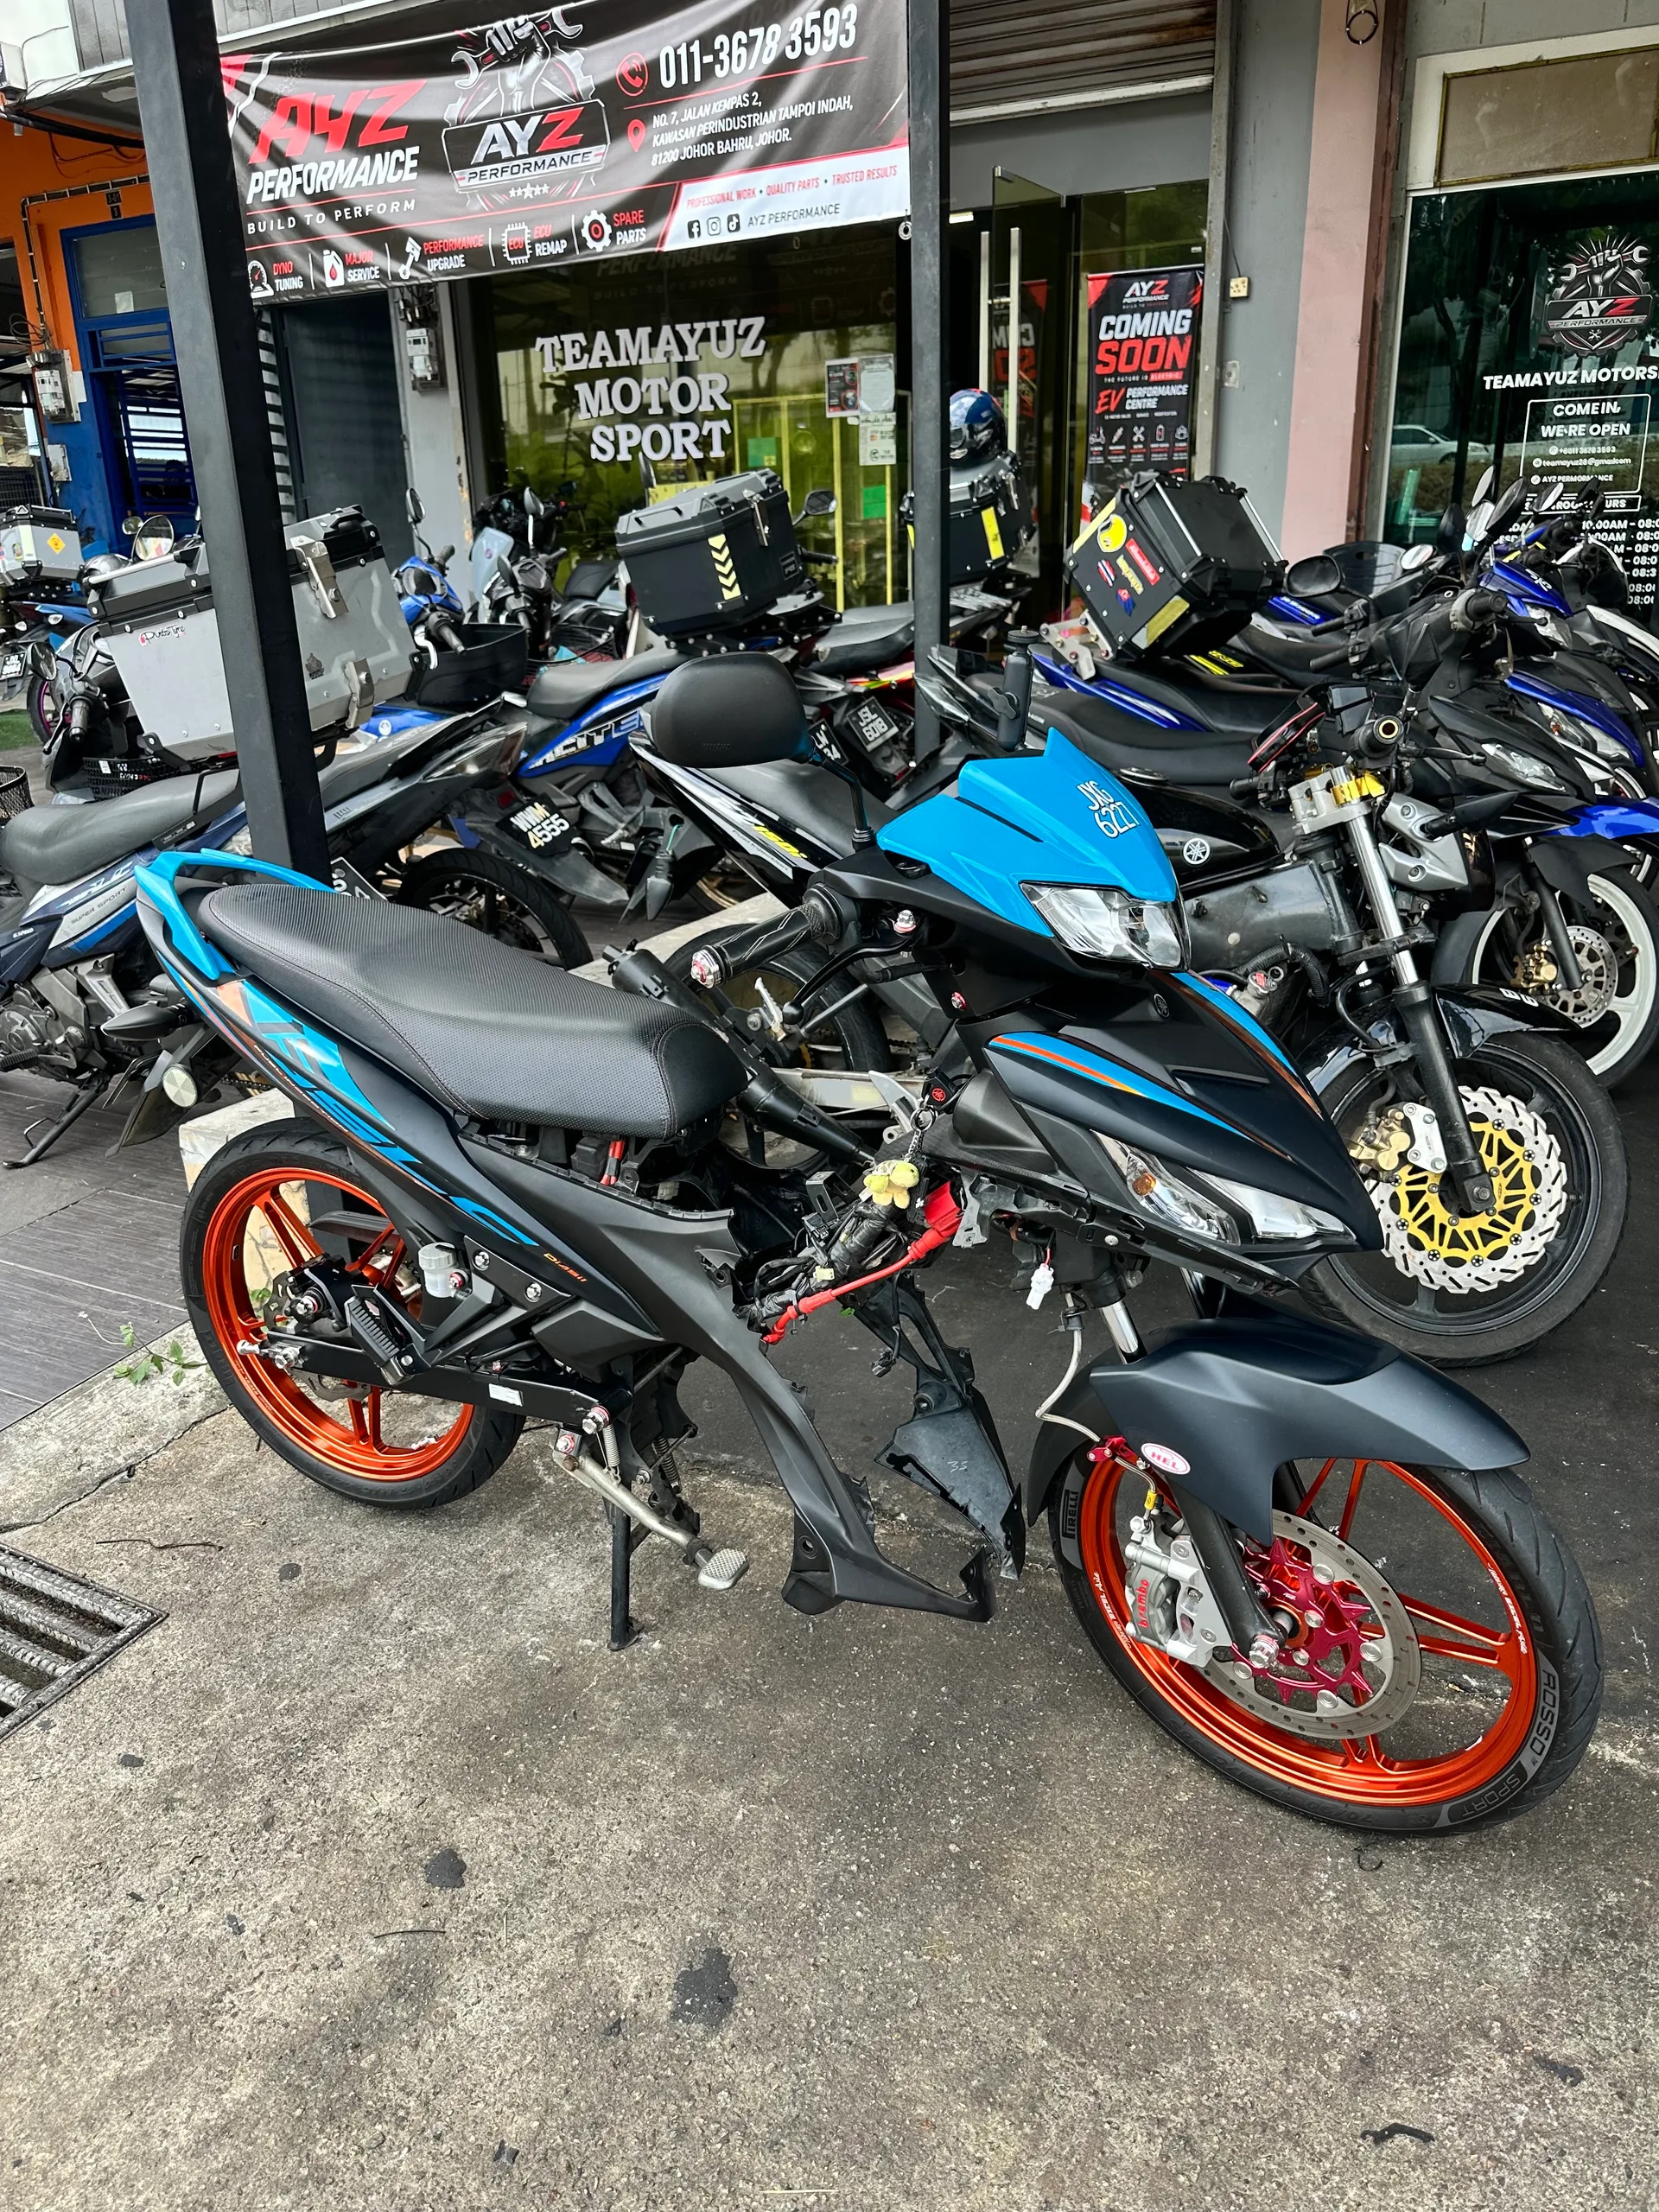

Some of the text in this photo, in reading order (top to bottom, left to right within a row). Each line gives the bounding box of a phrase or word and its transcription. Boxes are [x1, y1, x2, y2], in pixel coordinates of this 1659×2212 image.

[659, 3, 858, 88] 011-3678 3593
[248, 79, 427, 164] AYZ
[652, 92, 762, 129] NO. 7, JALAN KEMPAS 2,
[652, 95, 854, 148] KAWASAN PERINDUSTRIAN TAMPOI INDAH,
[471, 107, 583, 164] AYZ
[652, 129, 791, 167] 81200 JOHOR BAHRU, JOHOR.
[246, 145, 420, 204] PERFORMANCE
[467, 150, 593, 183] PERFORMANCE
[687, 165, 898, 209] PROFESSIONAL WORK QUALITY PARTS TRUSTED RESULTS
[248, 200, 416, 234] BUILD TO PERFORM
[613, 209, 645, 226] SPARE
[747, 203, 840, 228] AYZ PERFORMANCE
[423, 234, 484, 254] PERFORMANCE
[508, 236, 524, 250] ECU
[533, 224, 552, 239] ECU
[616, 228, 646, 245] PARTS
[346, 251, 373, 265] MAJOR
[427, 254, 465, 272] UPGRADE
[535, 240, 568, 257] REMAP
[273, 261, 293, 275] DYNO
[346, 265, 380, 283] SERVICE
[274, 276, 303, 291] TUNING
[1125, 280, 1168, 297] AYZ
[1556, 316, 1638, 328] PERFORMANCE
[1561, 297, 1641, 319] AYZ
[1099, 308, 1192, 340] COMING
[535, 316, 766, 373] TEAMAYUZ
[1095, 335, 1192, 374] SOON
[1127, 385, 1189, 397] PERFORMANCE
[1483, 365, 1659, 390] TEAMAYUZ MOTORS
[575, 372, 732, 420] MOTOR
[1095, 388, 1125, 414] EV
[1125, 397, 1158, 410] CENTRE
[1553, 401, 1622, 416] COME IN,
[590, 419, 732, 462] SPORT
[1589, 423, 1631, 435] OPEN
[1076, 780, 1115, 810] JXG
[510, 802, 550, 832] WWM
[527, 813, 570, 849] 4555
[71, 886, 128, 924] SUPER SPORT
[254, 1045, 348, 1132] FUEL INJECTION
[1150, 1451, 1180, 1471] HEL
[1061, 1489, 1079, 1539] PIRELLI
[1137, 1579, 1150, 1630] brembo
[1530, 1669, 1556, 1757] ROSSO
[1463, 1774, 1522, 1812] SPORT
